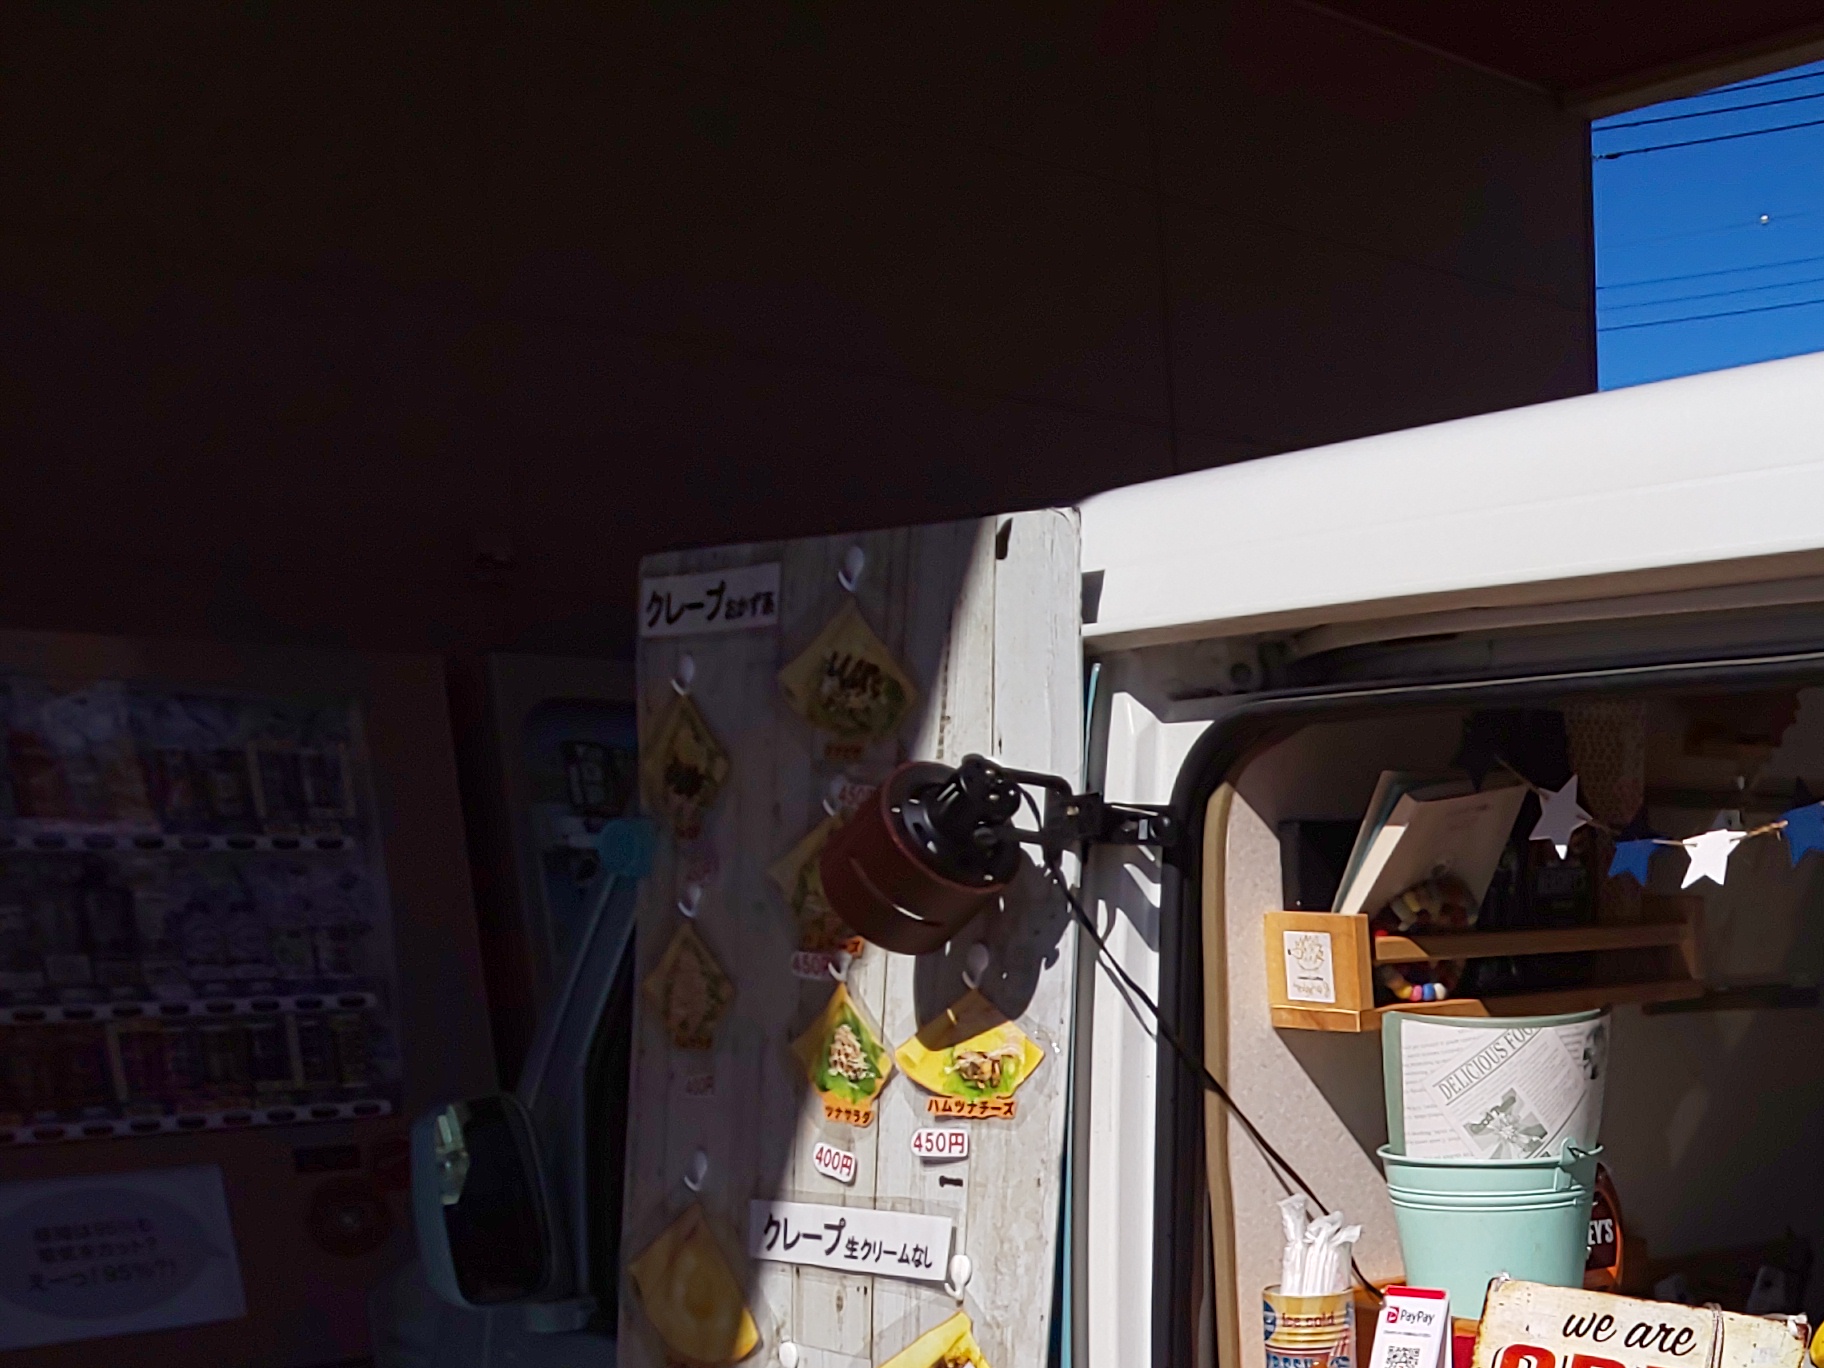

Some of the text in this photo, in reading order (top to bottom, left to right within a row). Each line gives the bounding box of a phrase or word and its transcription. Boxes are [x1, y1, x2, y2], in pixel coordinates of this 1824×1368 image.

[1438, 1041, 1508, 1101] DELICIOUS
[927, 1099, 1016, 1116] ハムツナチーズ
[913, 1132, 966, 1154] 450円
[815, 1146, 853, 1176] 400円
[1400, 1309, 1436, 1327] PayPay
[1562, 1312, 1698, 1356] we are
